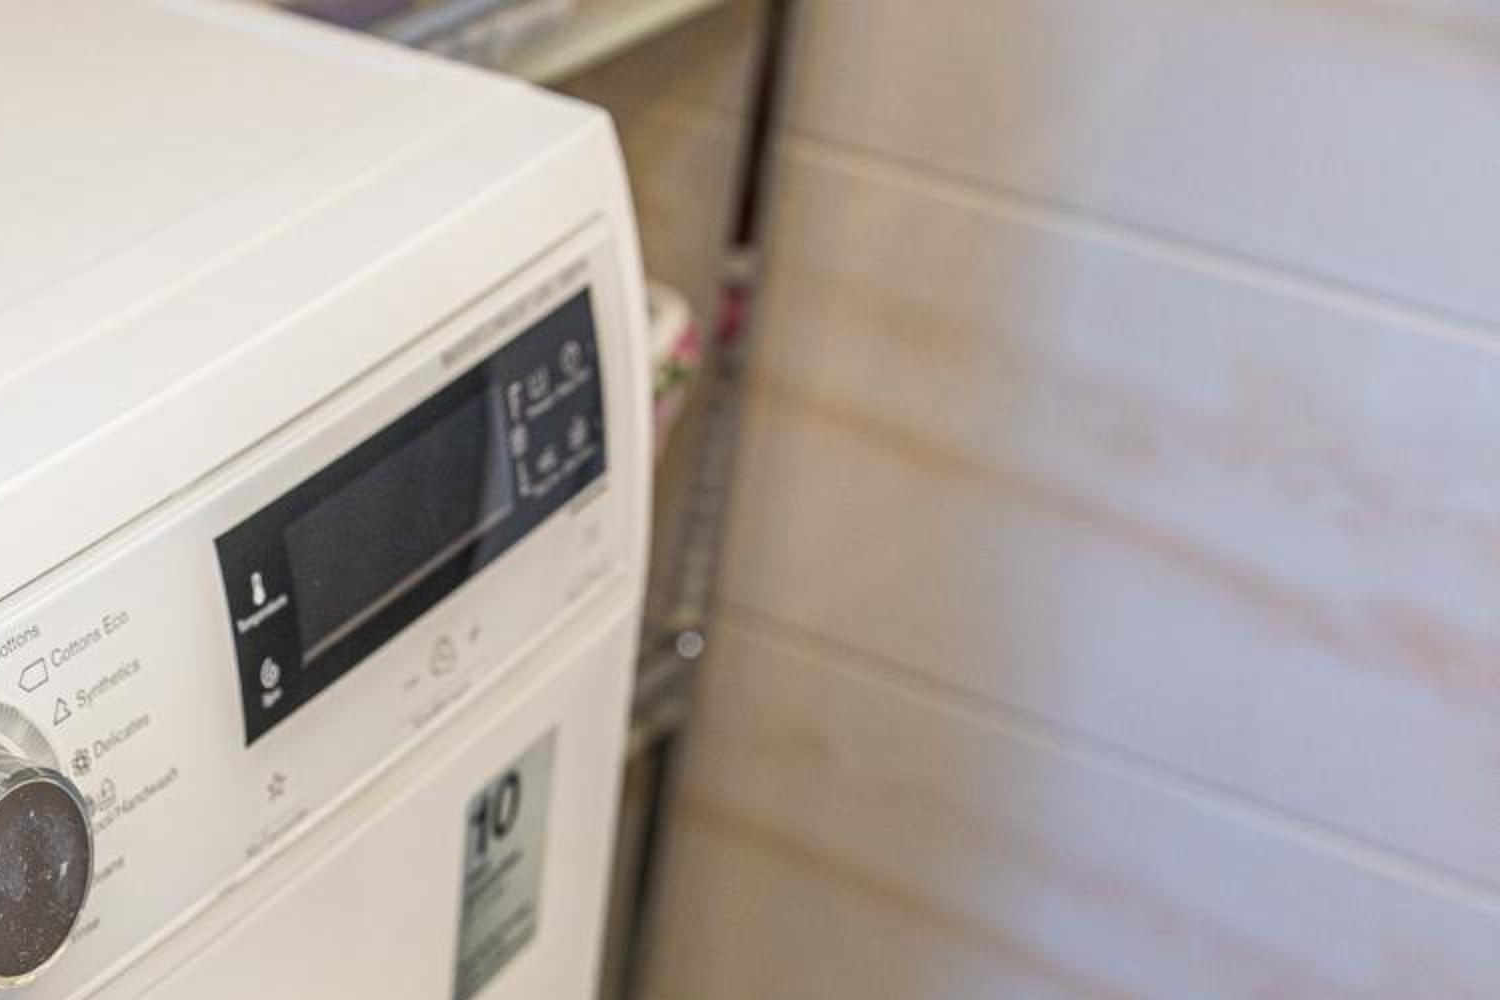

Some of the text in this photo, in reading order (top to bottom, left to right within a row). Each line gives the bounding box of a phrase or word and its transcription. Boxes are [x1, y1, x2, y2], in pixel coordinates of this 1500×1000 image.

[50, 611, 130, 668] Cottons Eco
[75, 658, 141, 708] Synthetics
[469, 768, 521, 856] 10
